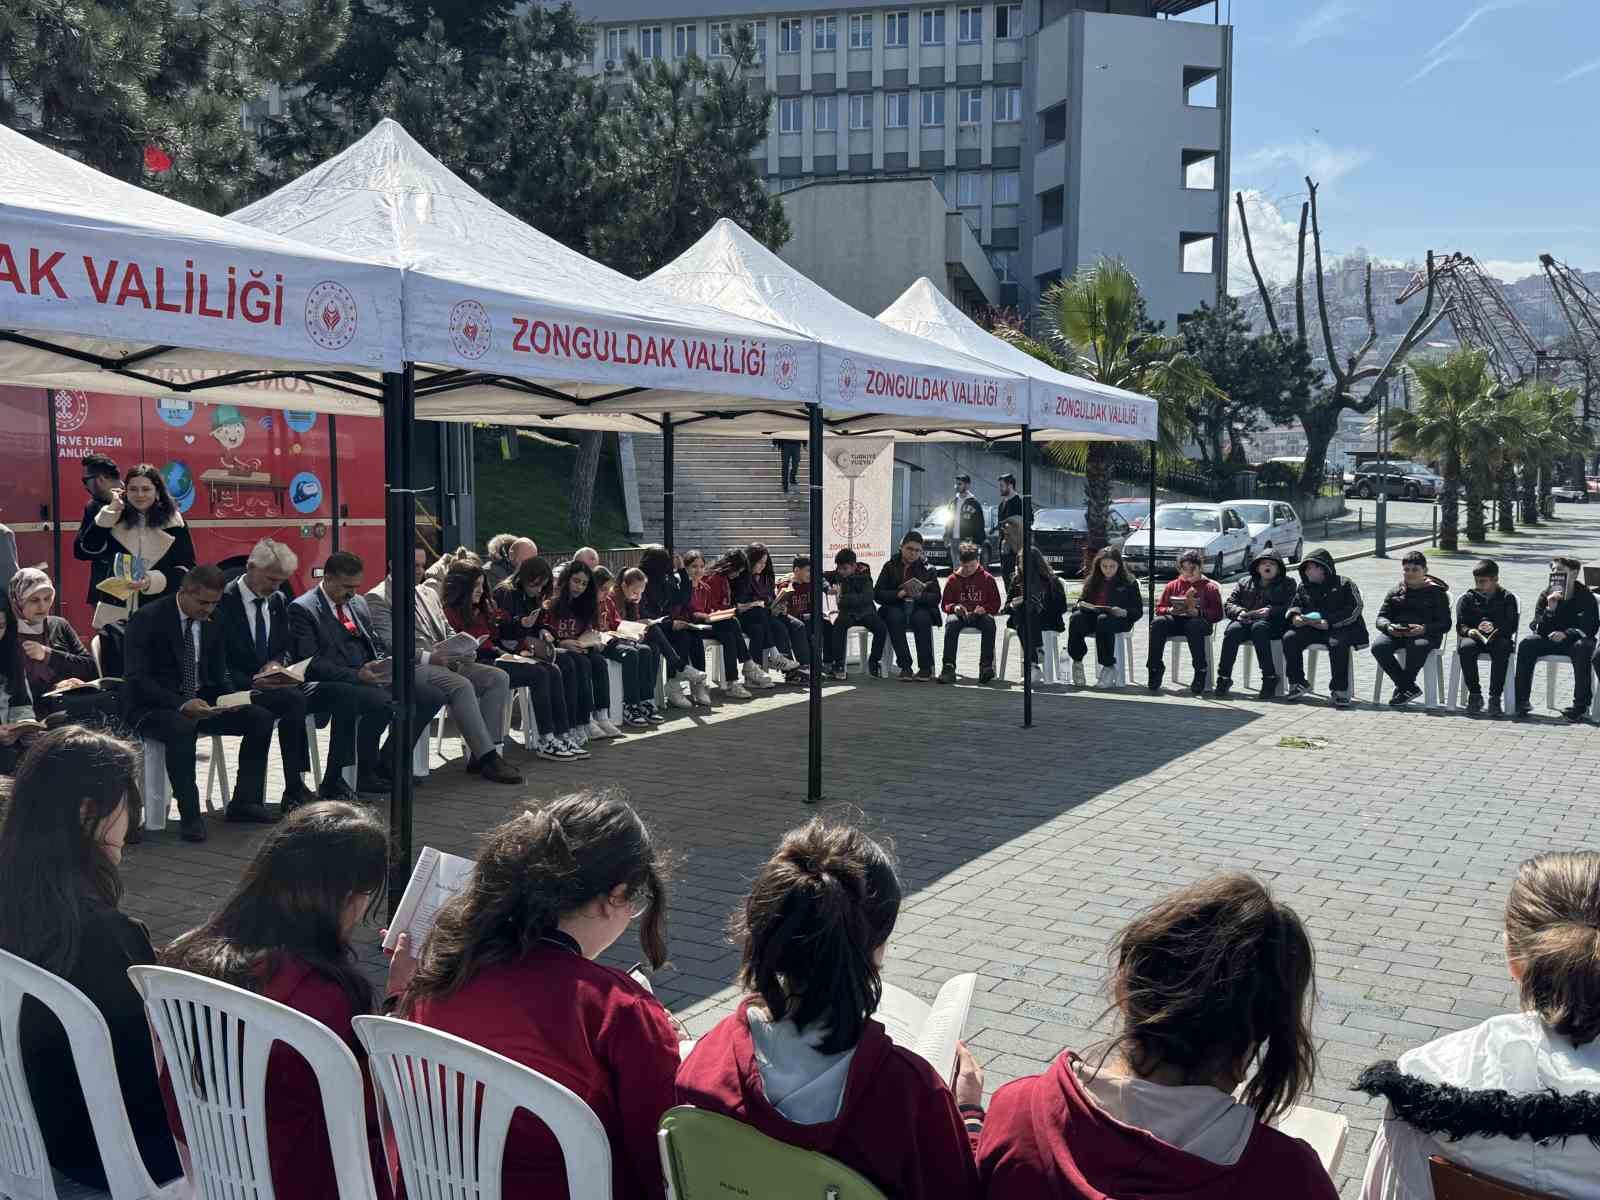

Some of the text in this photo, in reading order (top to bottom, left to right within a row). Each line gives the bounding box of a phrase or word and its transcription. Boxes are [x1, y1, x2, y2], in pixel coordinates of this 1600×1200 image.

[0, 243, 284, 325] AK VALİLİĞİ
[512, 318, 767, 376] ZONGULDAK VALİLİĞİ
[865, 369, 998, 406] ZONGULDAK VALİLİĞİ
[1056, 396, 1137, 424] ZONGULDAK VALİLİĞİ
[68, 436, 82, 446] VE
[84, 435, 122, 447] TURİZM
